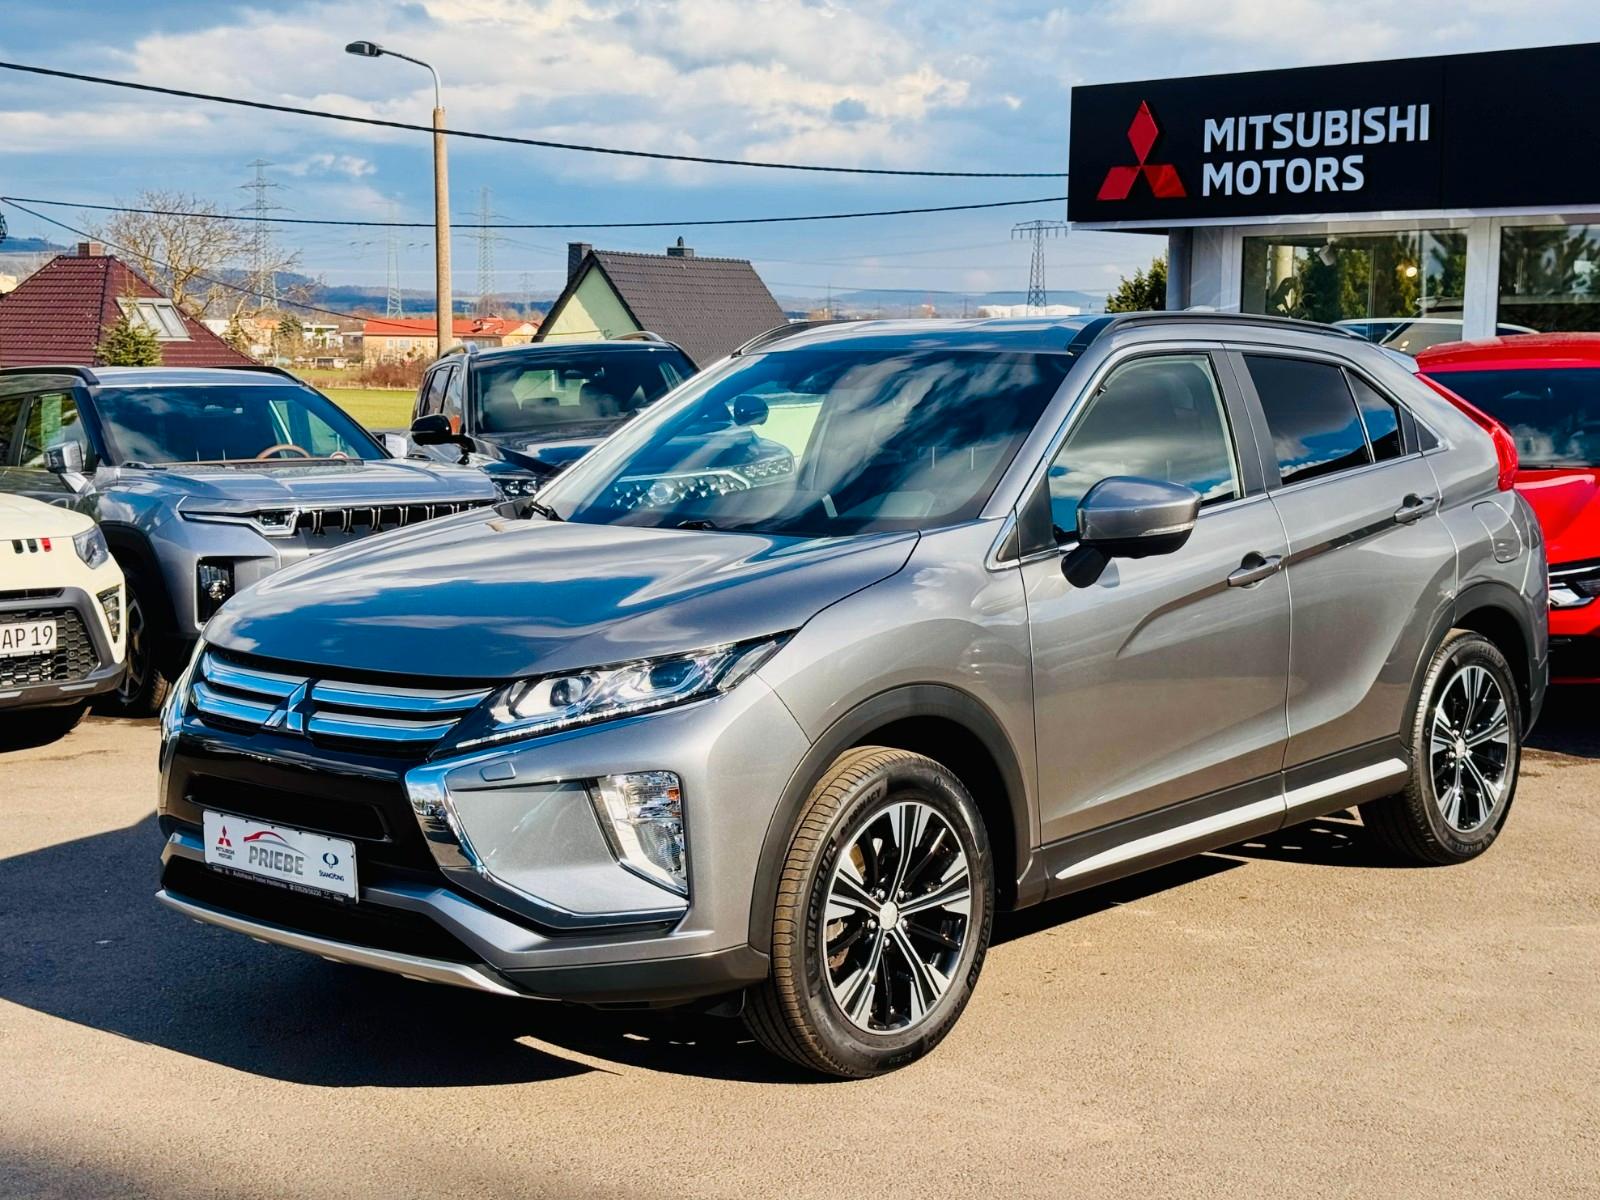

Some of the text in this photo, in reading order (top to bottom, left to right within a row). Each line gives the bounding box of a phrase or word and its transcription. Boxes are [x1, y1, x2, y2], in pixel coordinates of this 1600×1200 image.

[1204, 104, 1430, 153] MITSUBISHI
[1203, 155, 1364, 197] MOTORS
[2, 625, 53, 649] AP 19
[248, 845, 304, 876] PRIEBE
